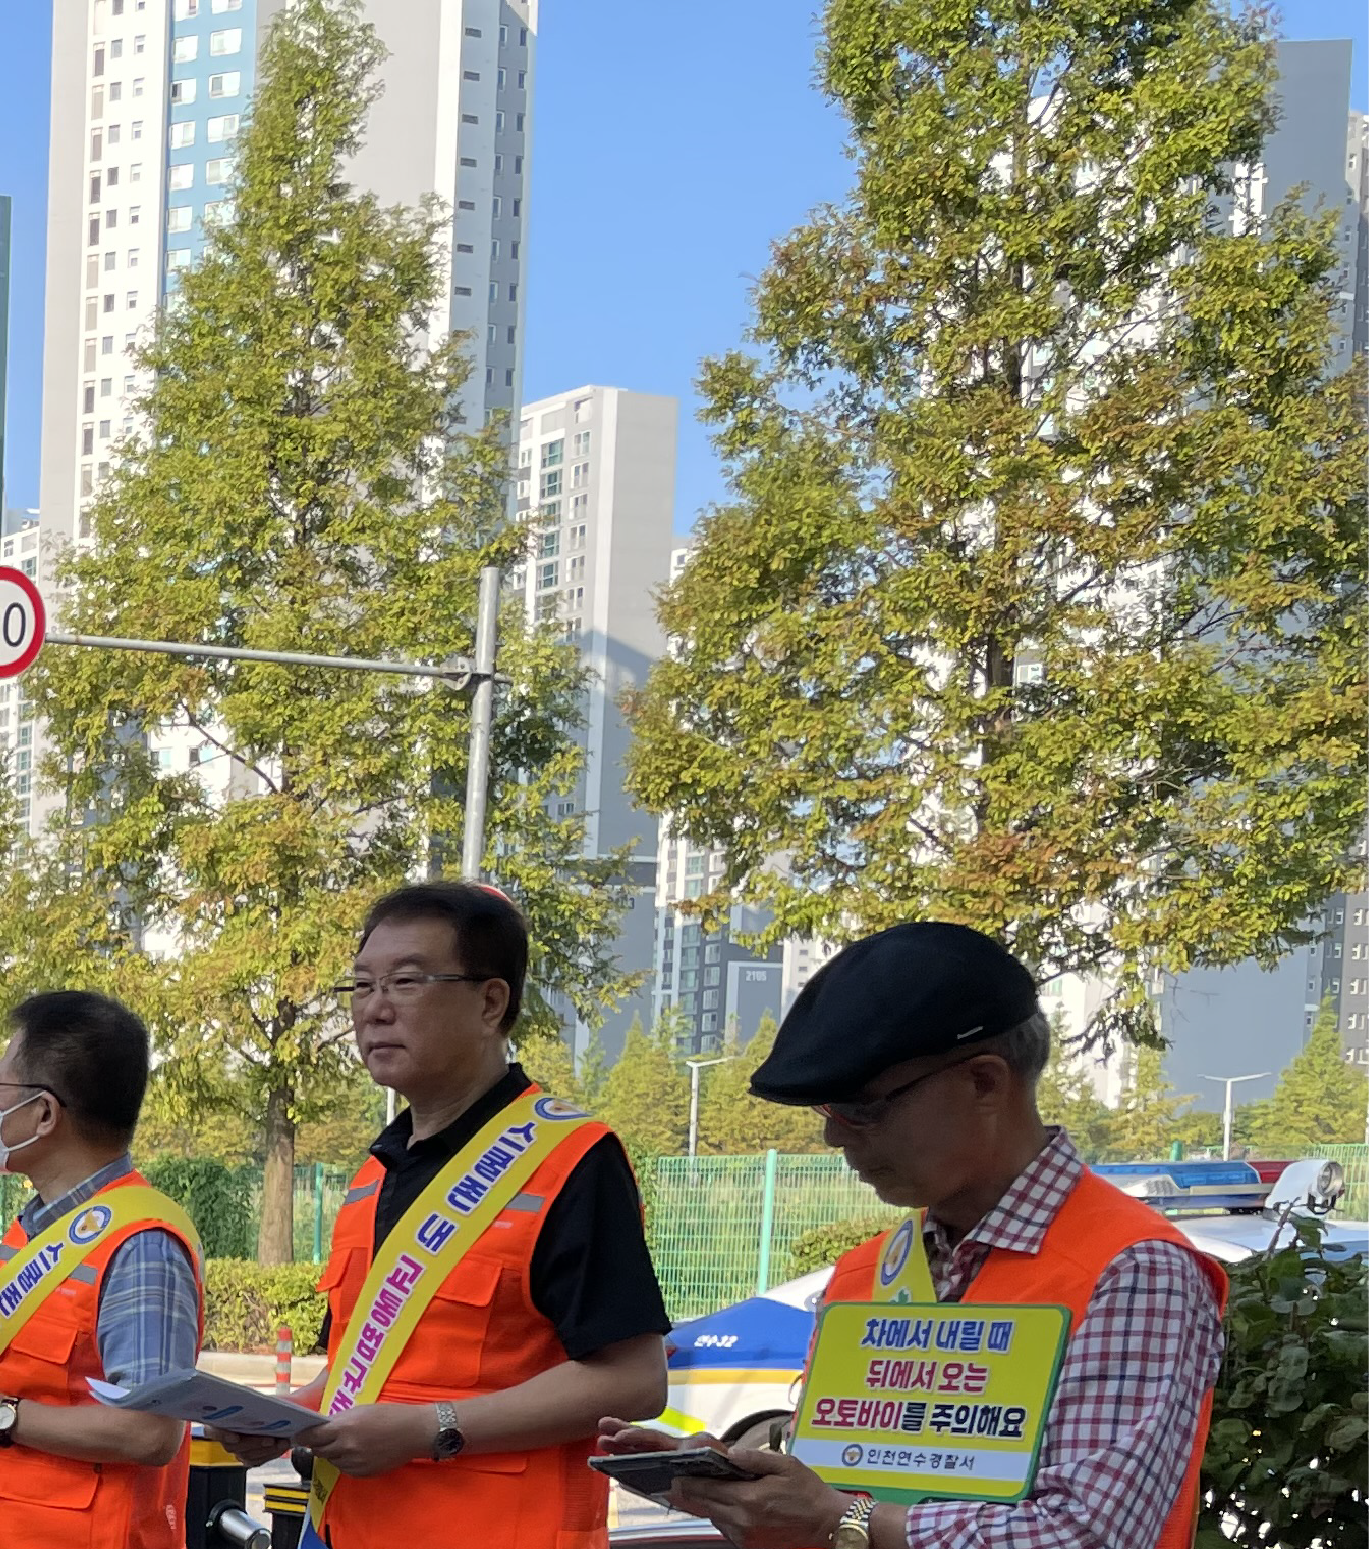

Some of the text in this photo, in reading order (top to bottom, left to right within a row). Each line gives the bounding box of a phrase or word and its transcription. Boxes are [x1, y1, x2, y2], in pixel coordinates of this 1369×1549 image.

[446, 1120, 538, 1213] 스쿨존
[415, 1212, 457, 1254] 내
[860, 1317, 1014, 1353] 차에서 내릴 때
[865, 1359, 989, 1394] 뒤에서 오는
[810, 1397, 1027, 1439] 오토바이를 주의해요
[866, 1448, 976, 1471] 인천연수경찰서
